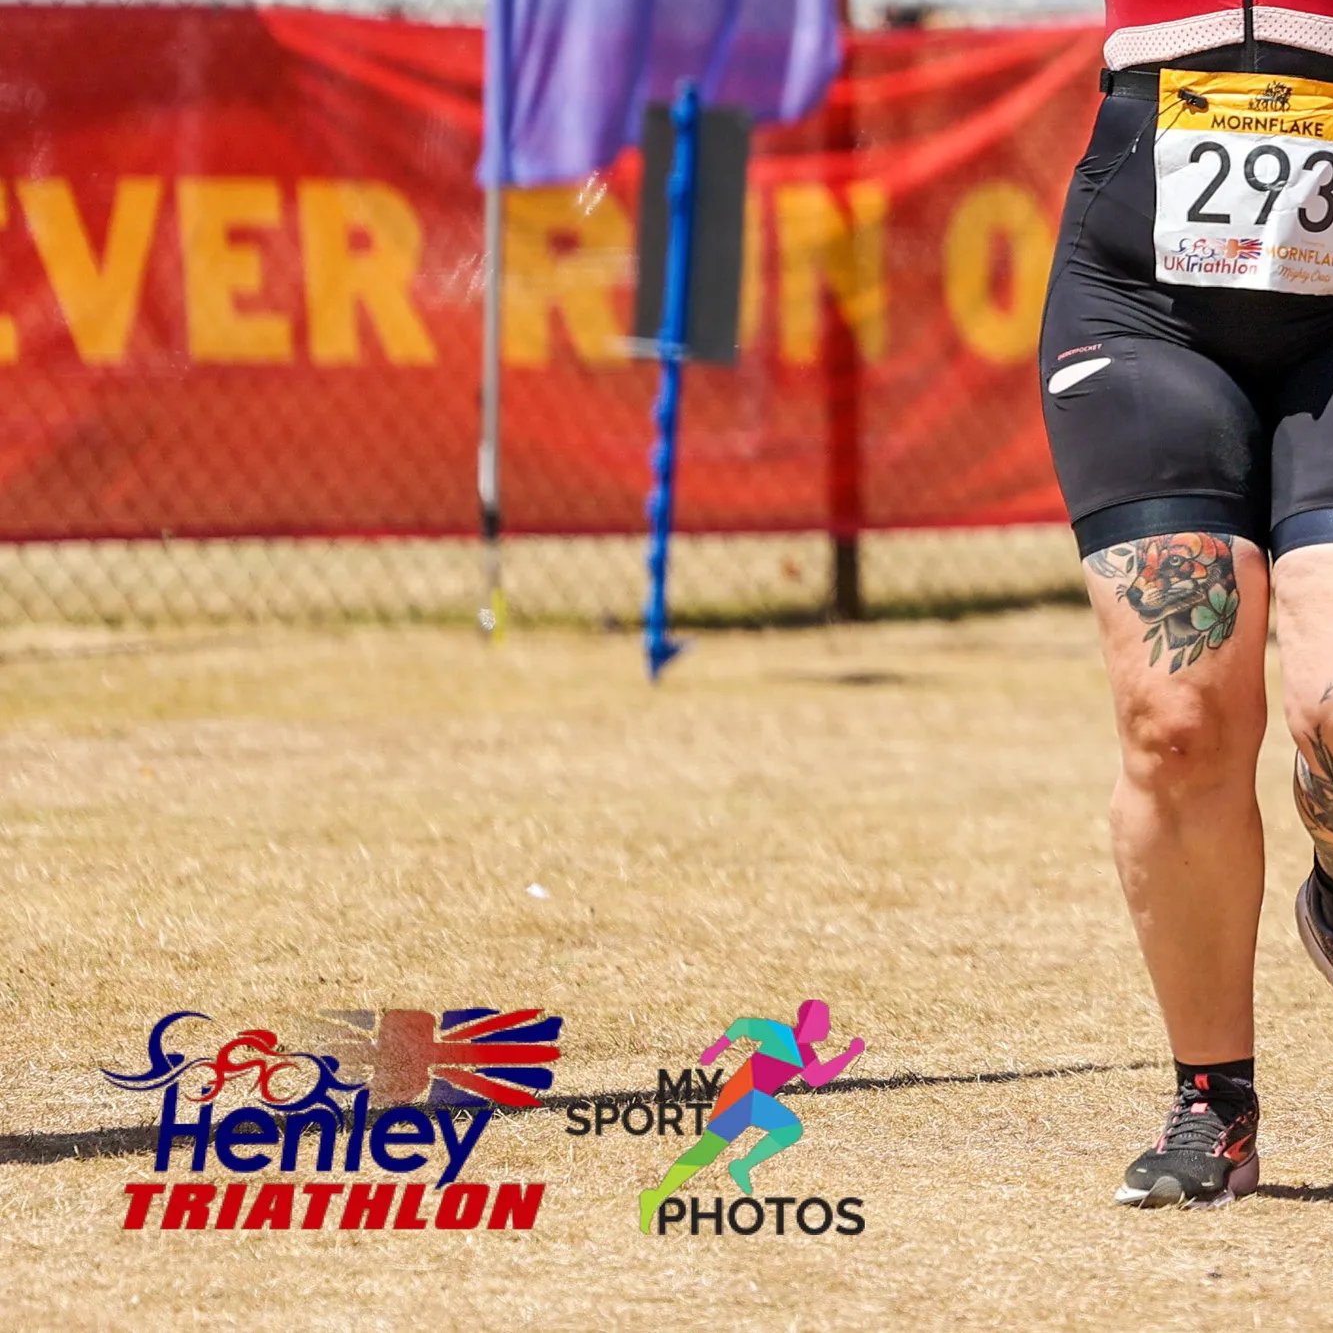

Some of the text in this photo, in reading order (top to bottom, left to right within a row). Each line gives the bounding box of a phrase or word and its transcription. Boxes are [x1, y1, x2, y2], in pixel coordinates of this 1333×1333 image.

[1211, 113, 1325, 137] MORNFLAKE
[0, 176, 437, 365] VER
[944, 178, 1056, 365] O
